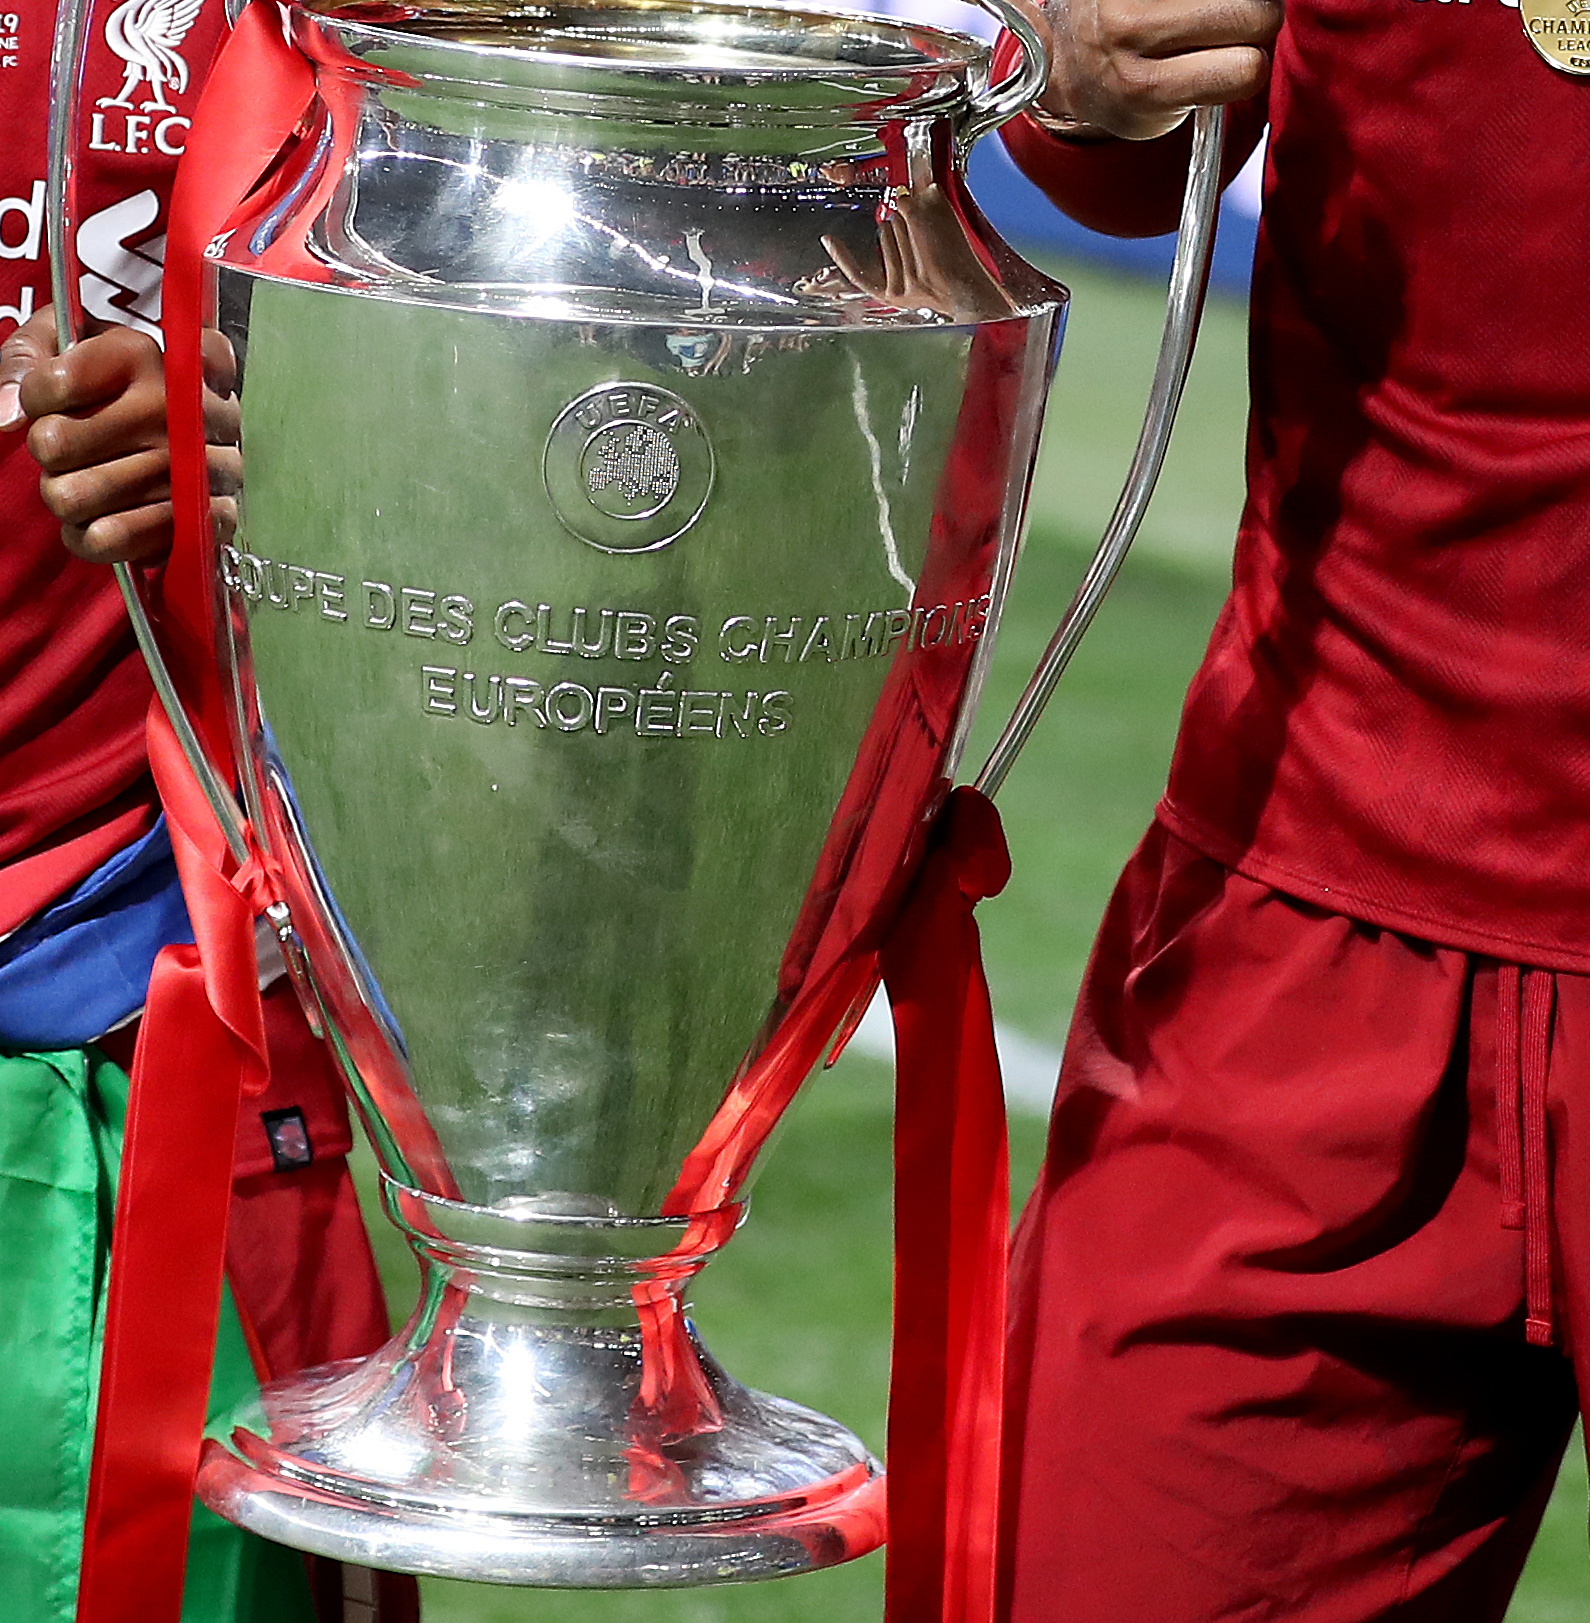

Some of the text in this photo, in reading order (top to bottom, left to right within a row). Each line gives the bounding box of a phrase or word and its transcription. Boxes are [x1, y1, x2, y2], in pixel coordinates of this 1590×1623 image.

[574, 392, 681, 434] UEFA
[220, 542, 991, 664] COUPE DES CLUBS CHAMPIONS
[421, 664, 795, 740] EUROPÉENS
